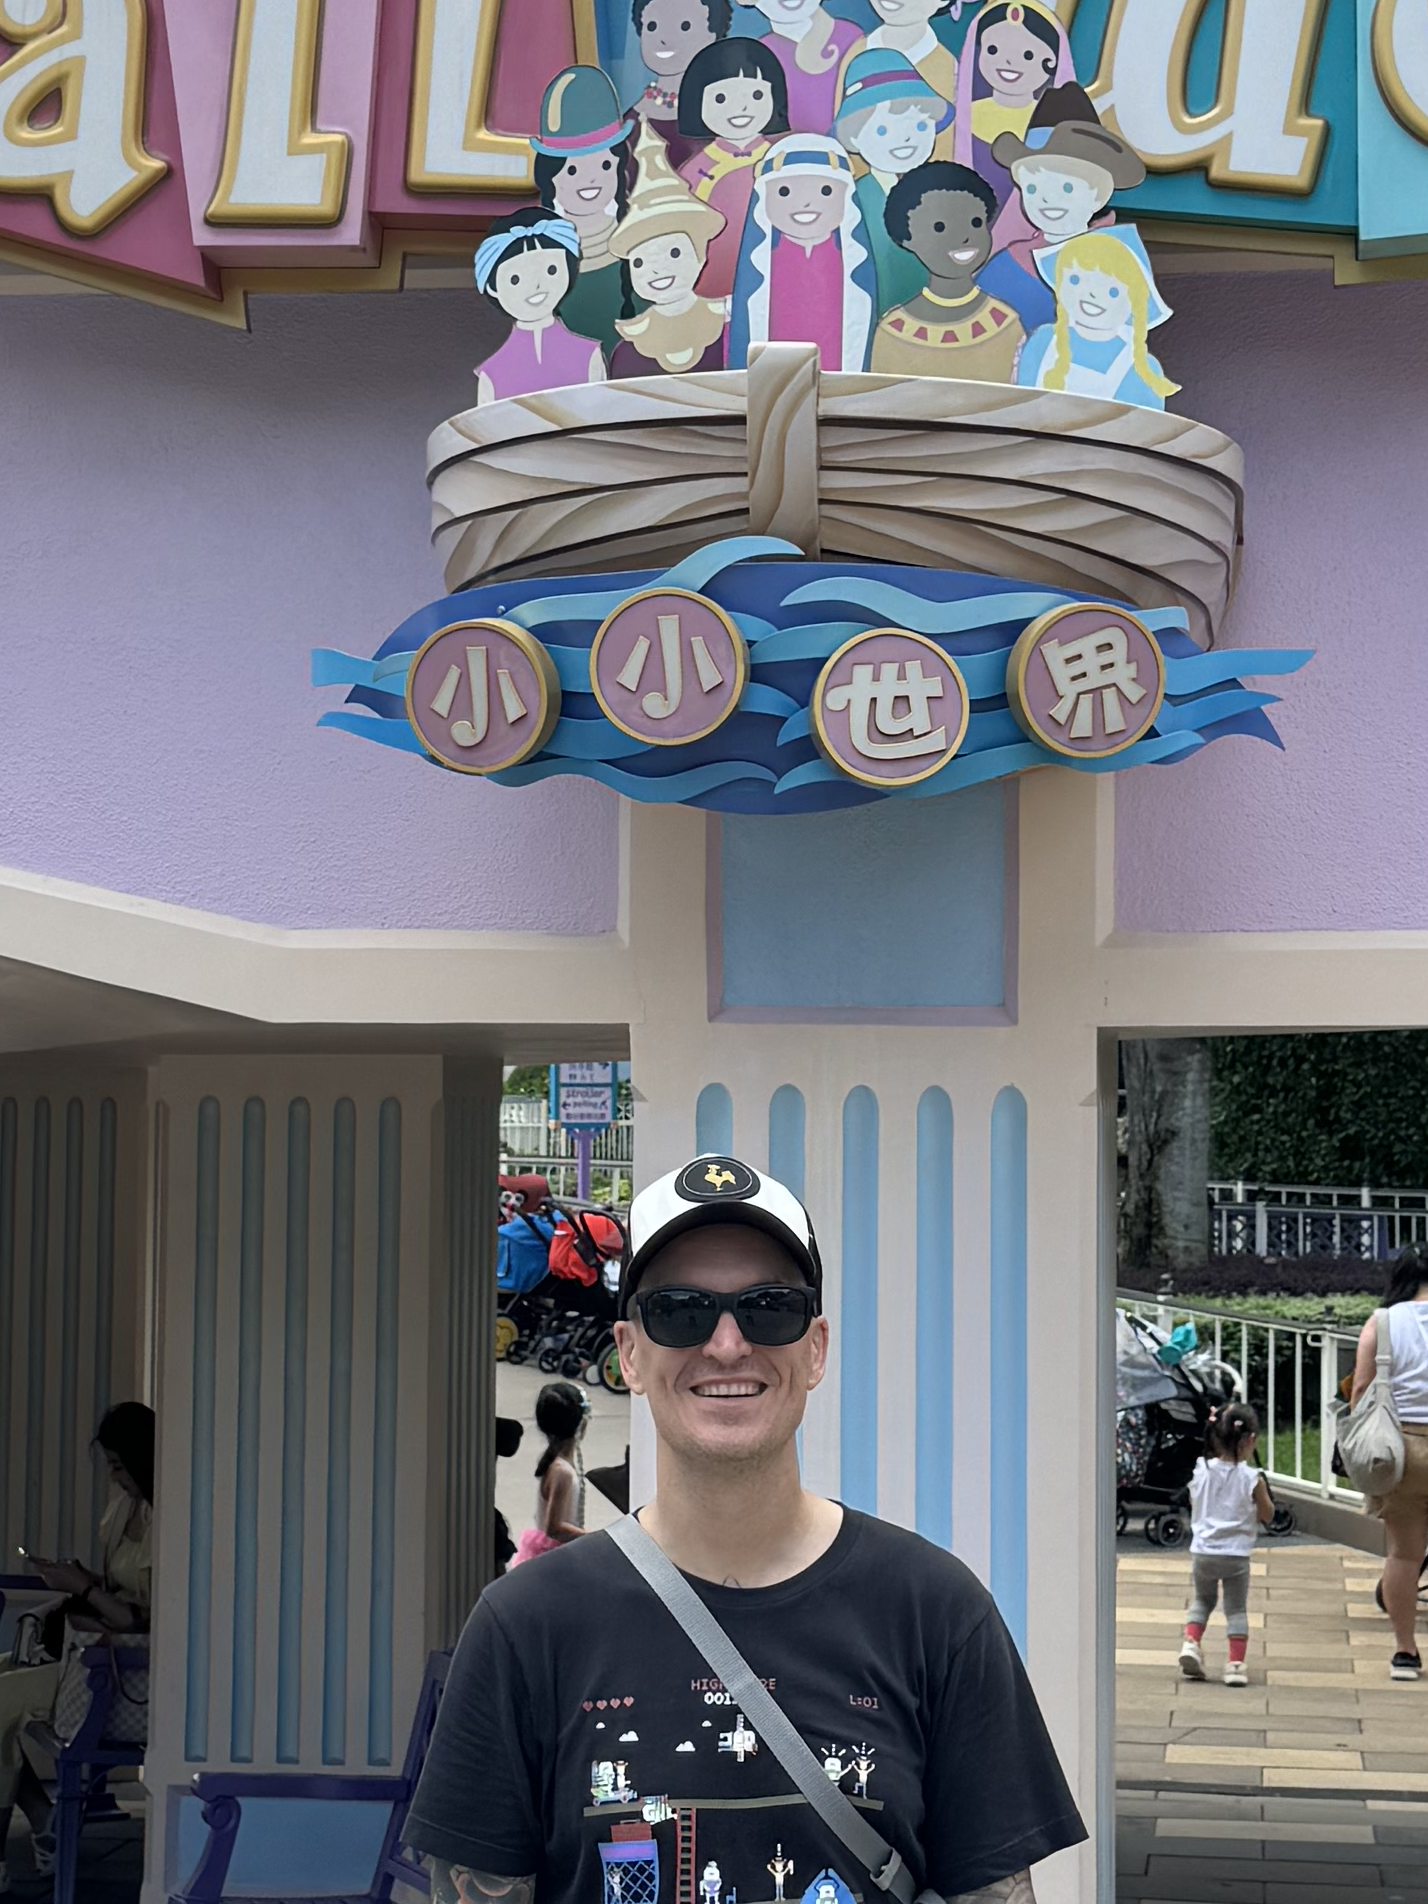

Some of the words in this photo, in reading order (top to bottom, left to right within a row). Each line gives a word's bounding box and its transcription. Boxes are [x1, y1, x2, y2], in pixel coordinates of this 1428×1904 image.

[430, 613, 1149, 761] 小小世界
[704, 1692, 739, 1705] 001
